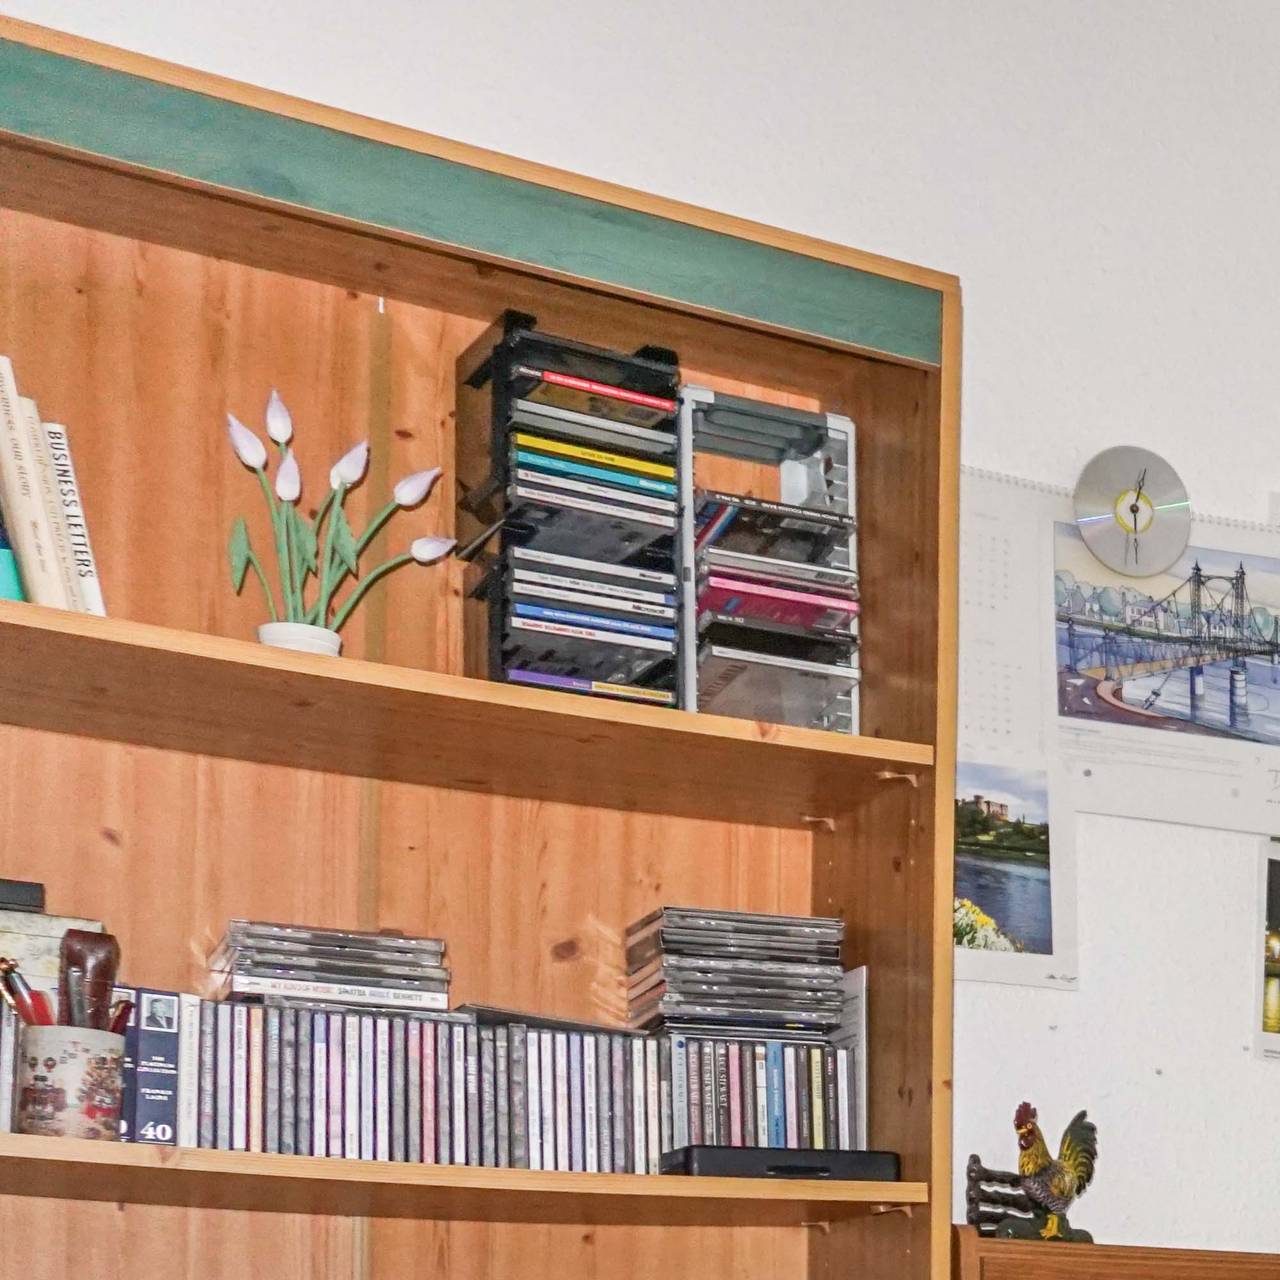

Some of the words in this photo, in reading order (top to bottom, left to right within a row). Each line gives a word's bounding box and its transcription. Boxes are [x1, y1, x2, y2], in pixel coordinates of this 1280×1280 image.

[47, 430, 78, 509] BUSINESS
[64, 514, 94, 579] LETTERS
[140, 1121, 172, 1141] 40
